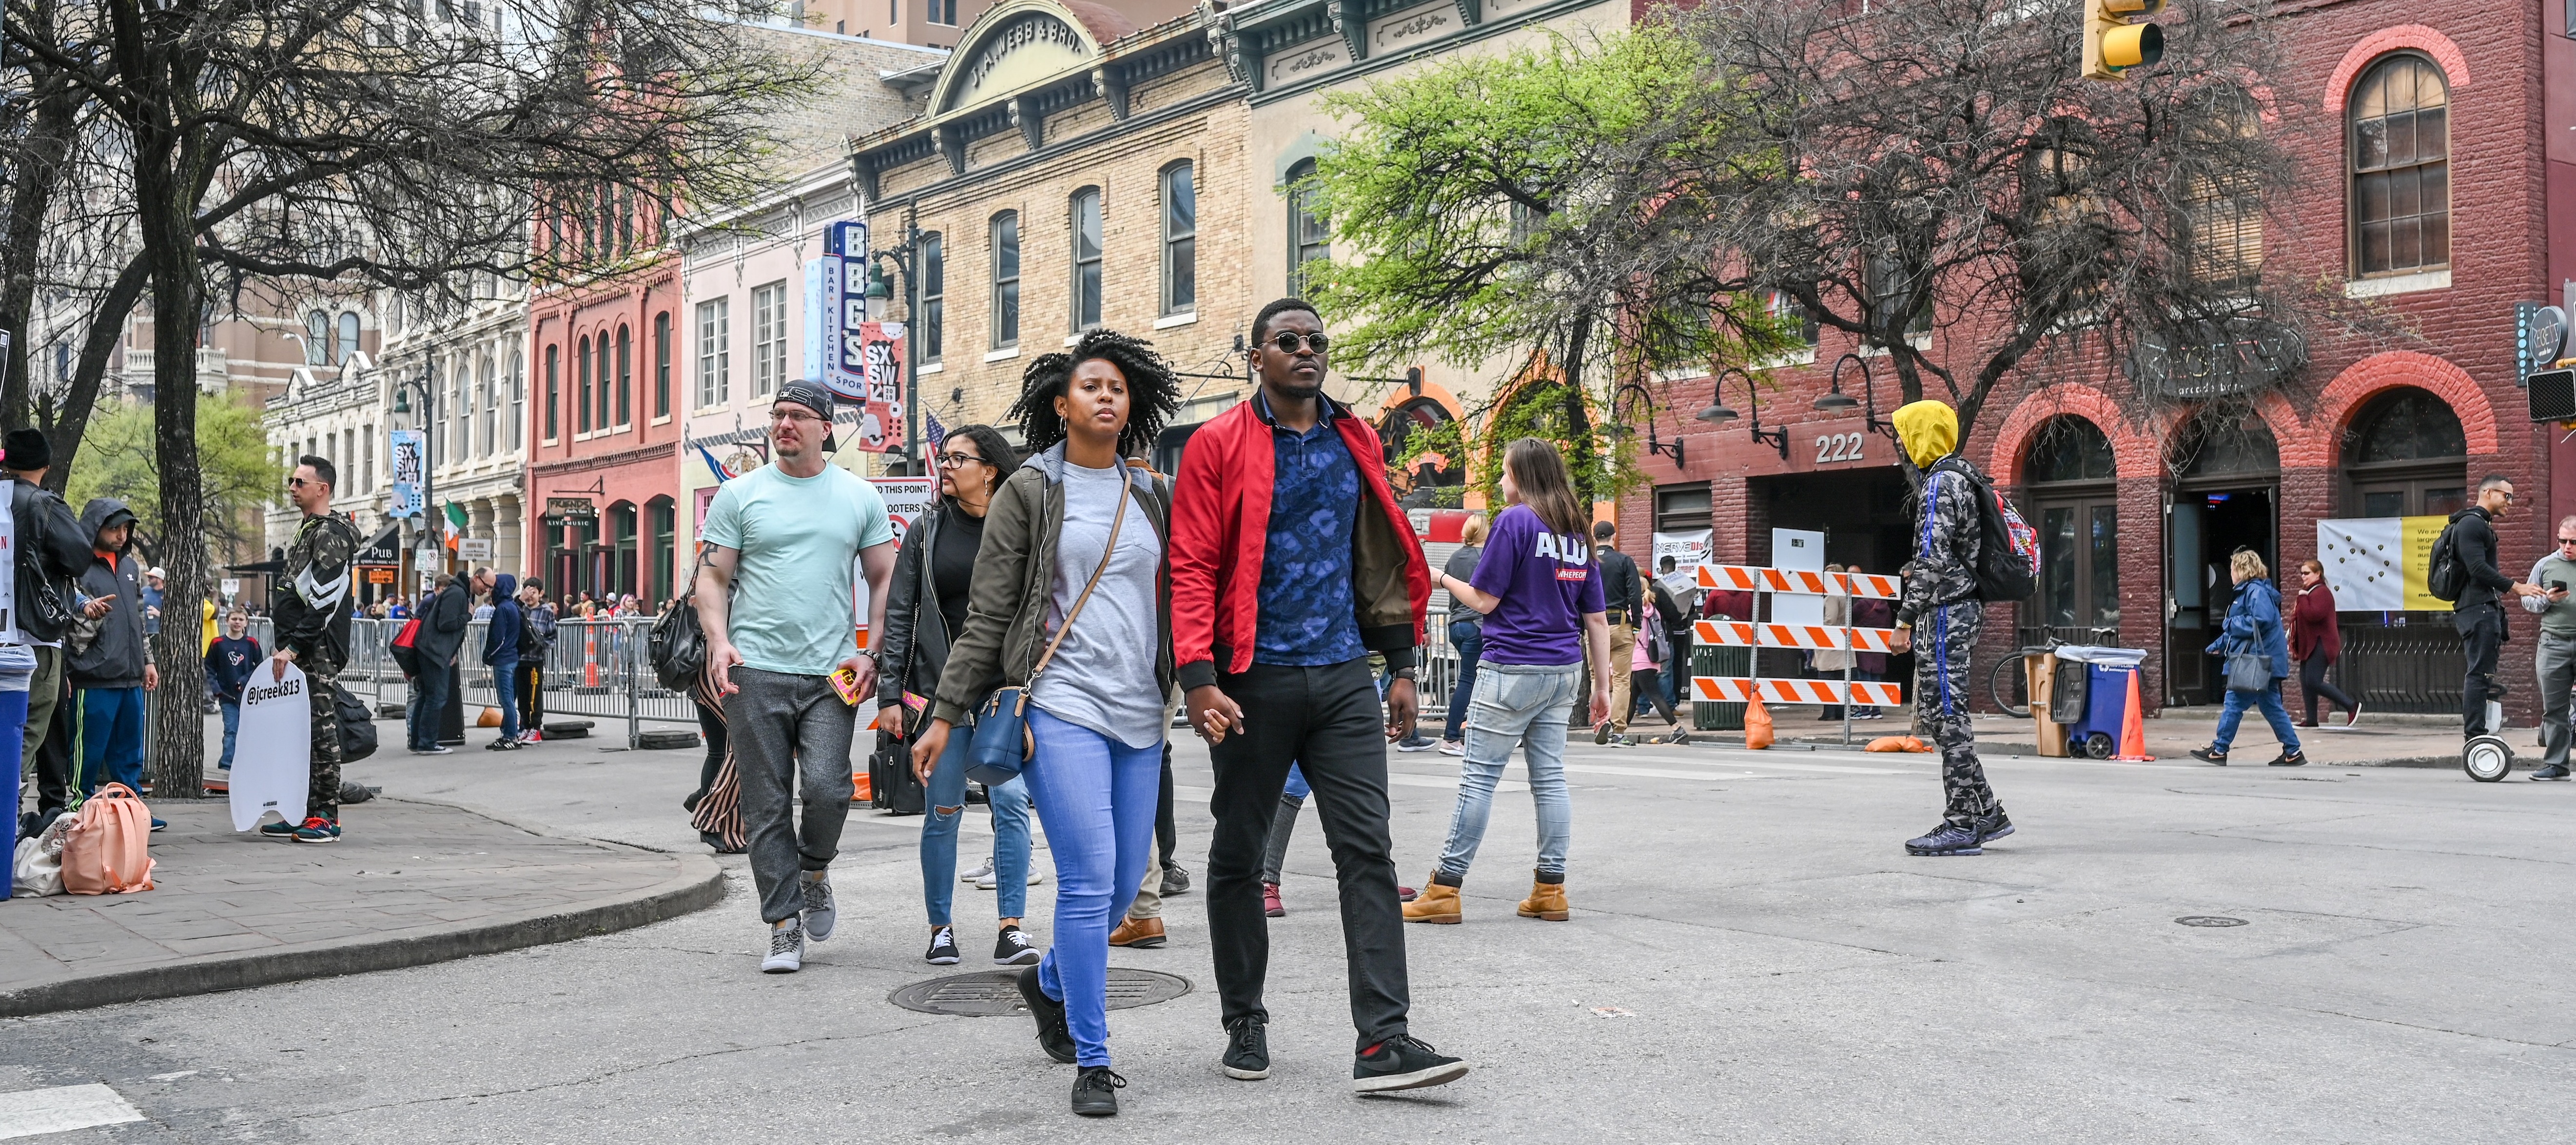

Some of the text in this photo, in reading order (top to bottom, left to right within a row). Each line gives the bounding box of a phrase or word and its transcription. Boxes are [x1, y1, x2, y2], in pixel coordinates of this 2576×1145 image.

[865, 345, 891, 365] SX
[868, 364, 896, 386] SW
[836, 376, 864, 390] SPOR
[394, 445, 412, 459] SX
[1815, 432, 1863, 463] 222
[395, 458, 417, 473] SW
[885, 486, 902, 494] THIS
[904, 485, 930, 494] POINT:
[887, 504, 920, 513] OOTERS
[247, 679, 300, 705] @jcreek813
